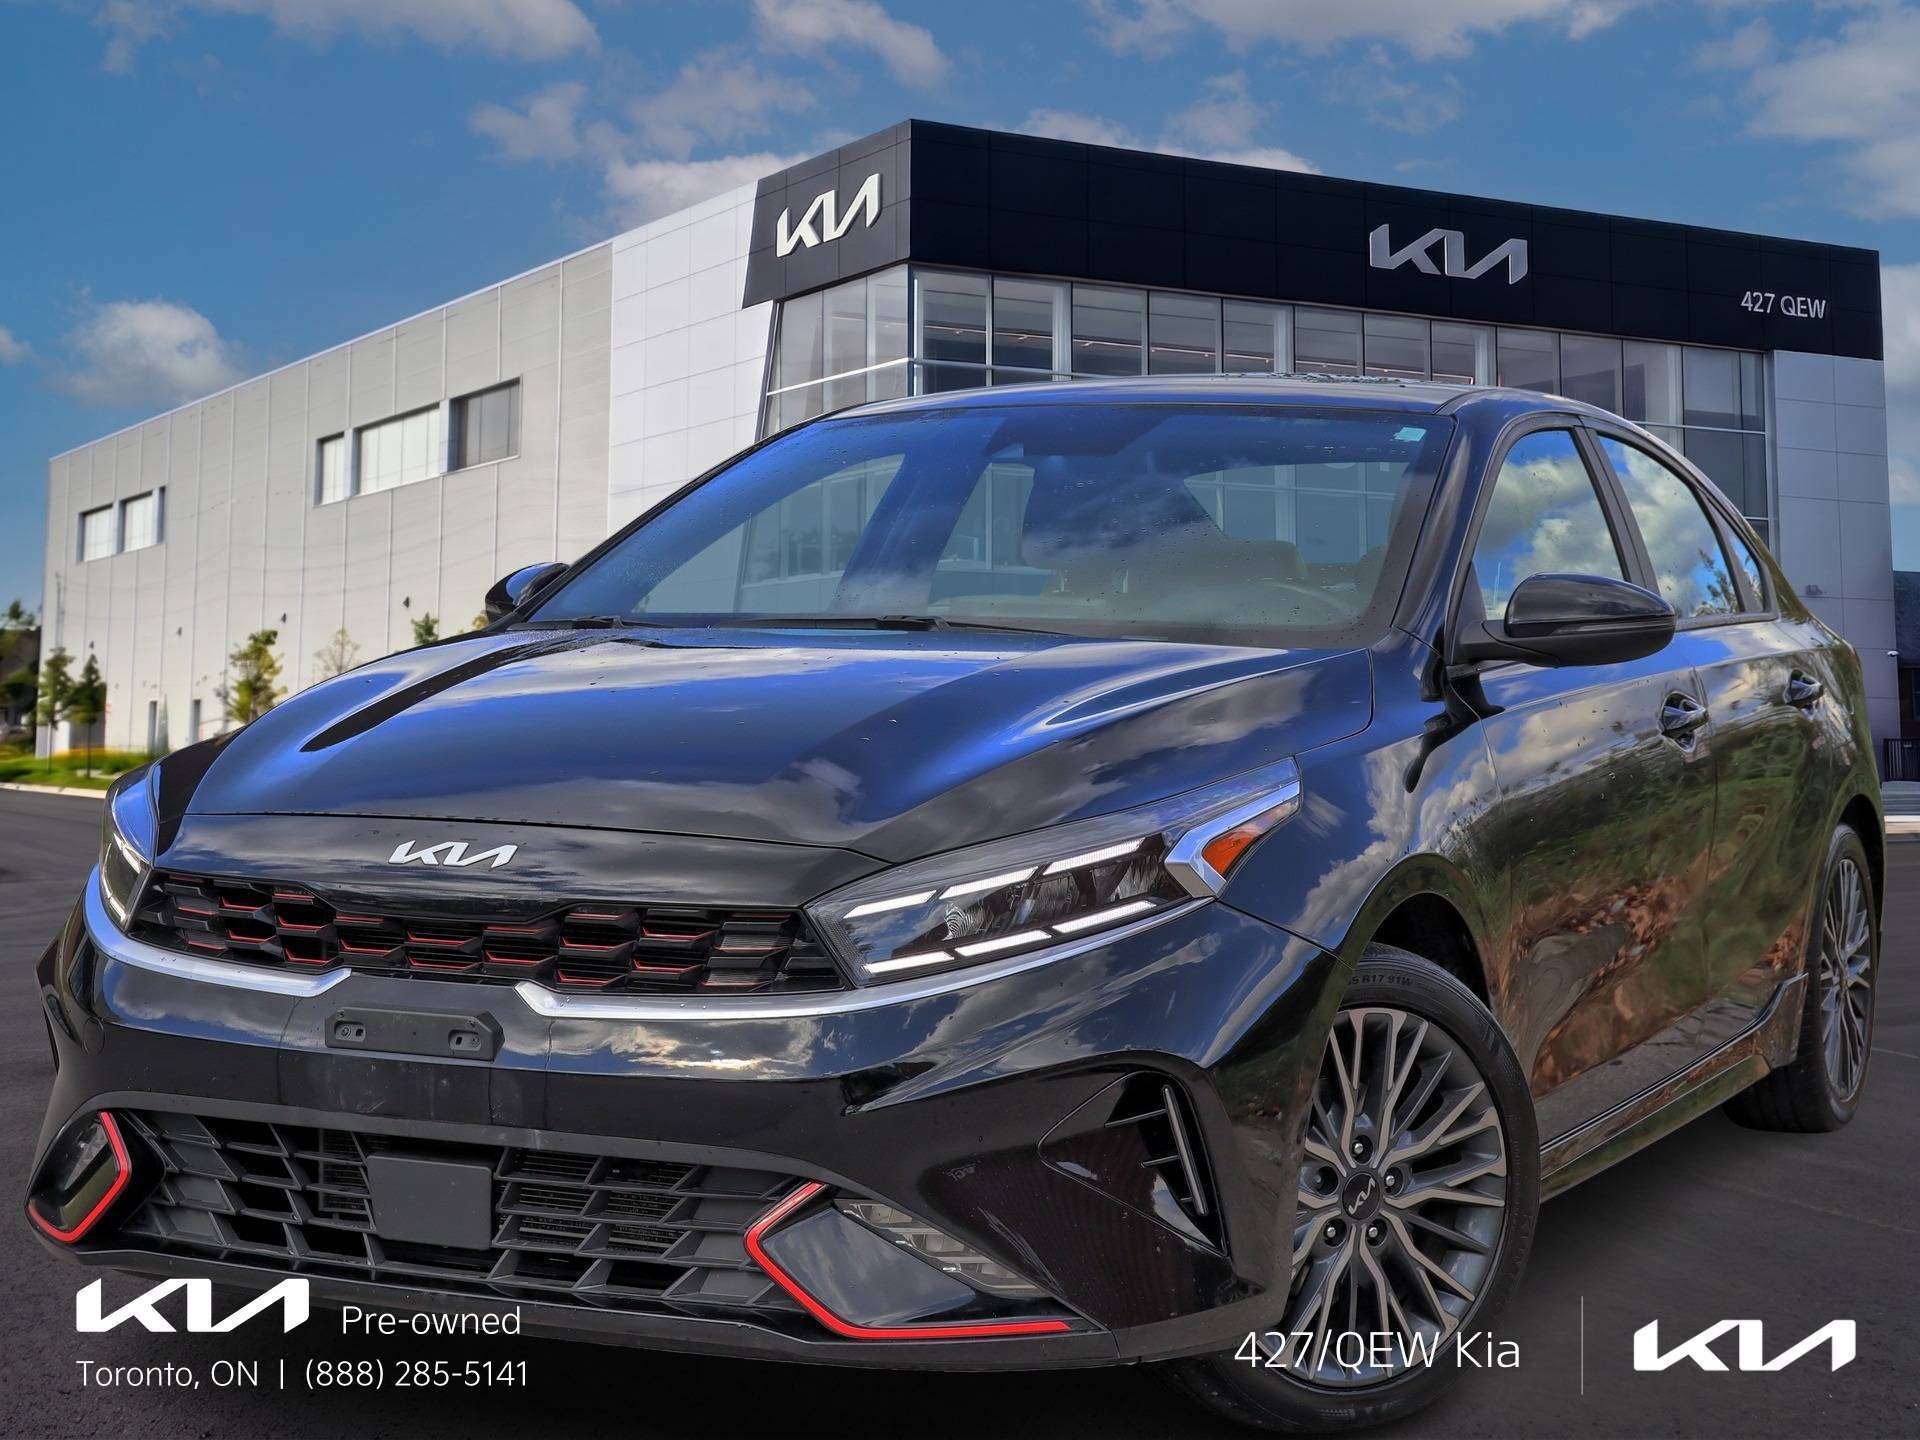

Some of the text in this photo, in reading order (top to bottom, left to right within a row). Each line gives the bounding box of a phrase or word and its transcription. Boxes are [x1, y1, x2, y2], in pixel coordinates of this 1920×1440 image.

[776, 172, 880, 258] KIA
[1369, 223, 1529, 286] KIA
[1740, 290, 1826, 319] 427 QEW
[388, 839, 518, 869] KIA
